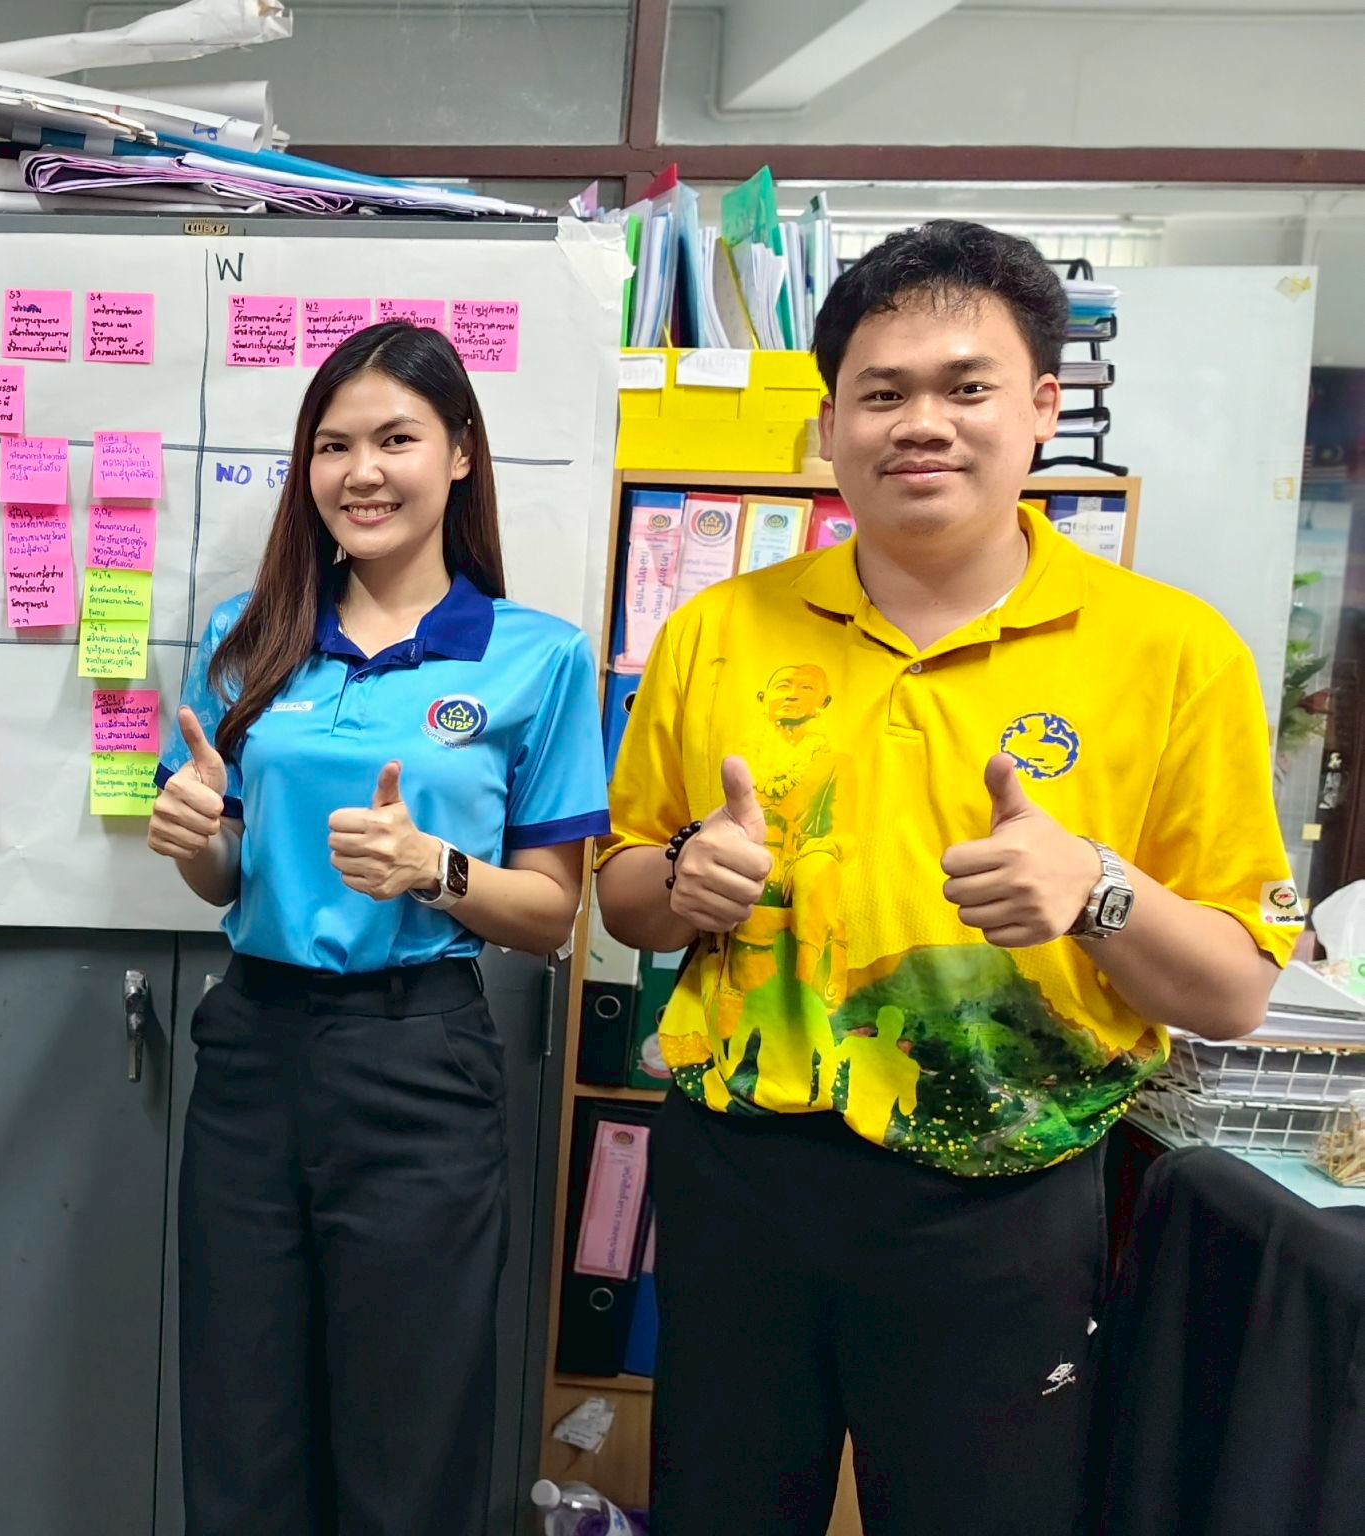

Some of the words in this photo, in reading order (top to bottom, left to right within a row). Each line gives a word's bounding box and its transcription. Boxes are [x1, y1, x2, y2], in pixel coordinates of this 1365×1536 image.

[216, 252, 244, 281] W
[9, 290, 21, 299] S3
[91, 293, 102, 301] S4
